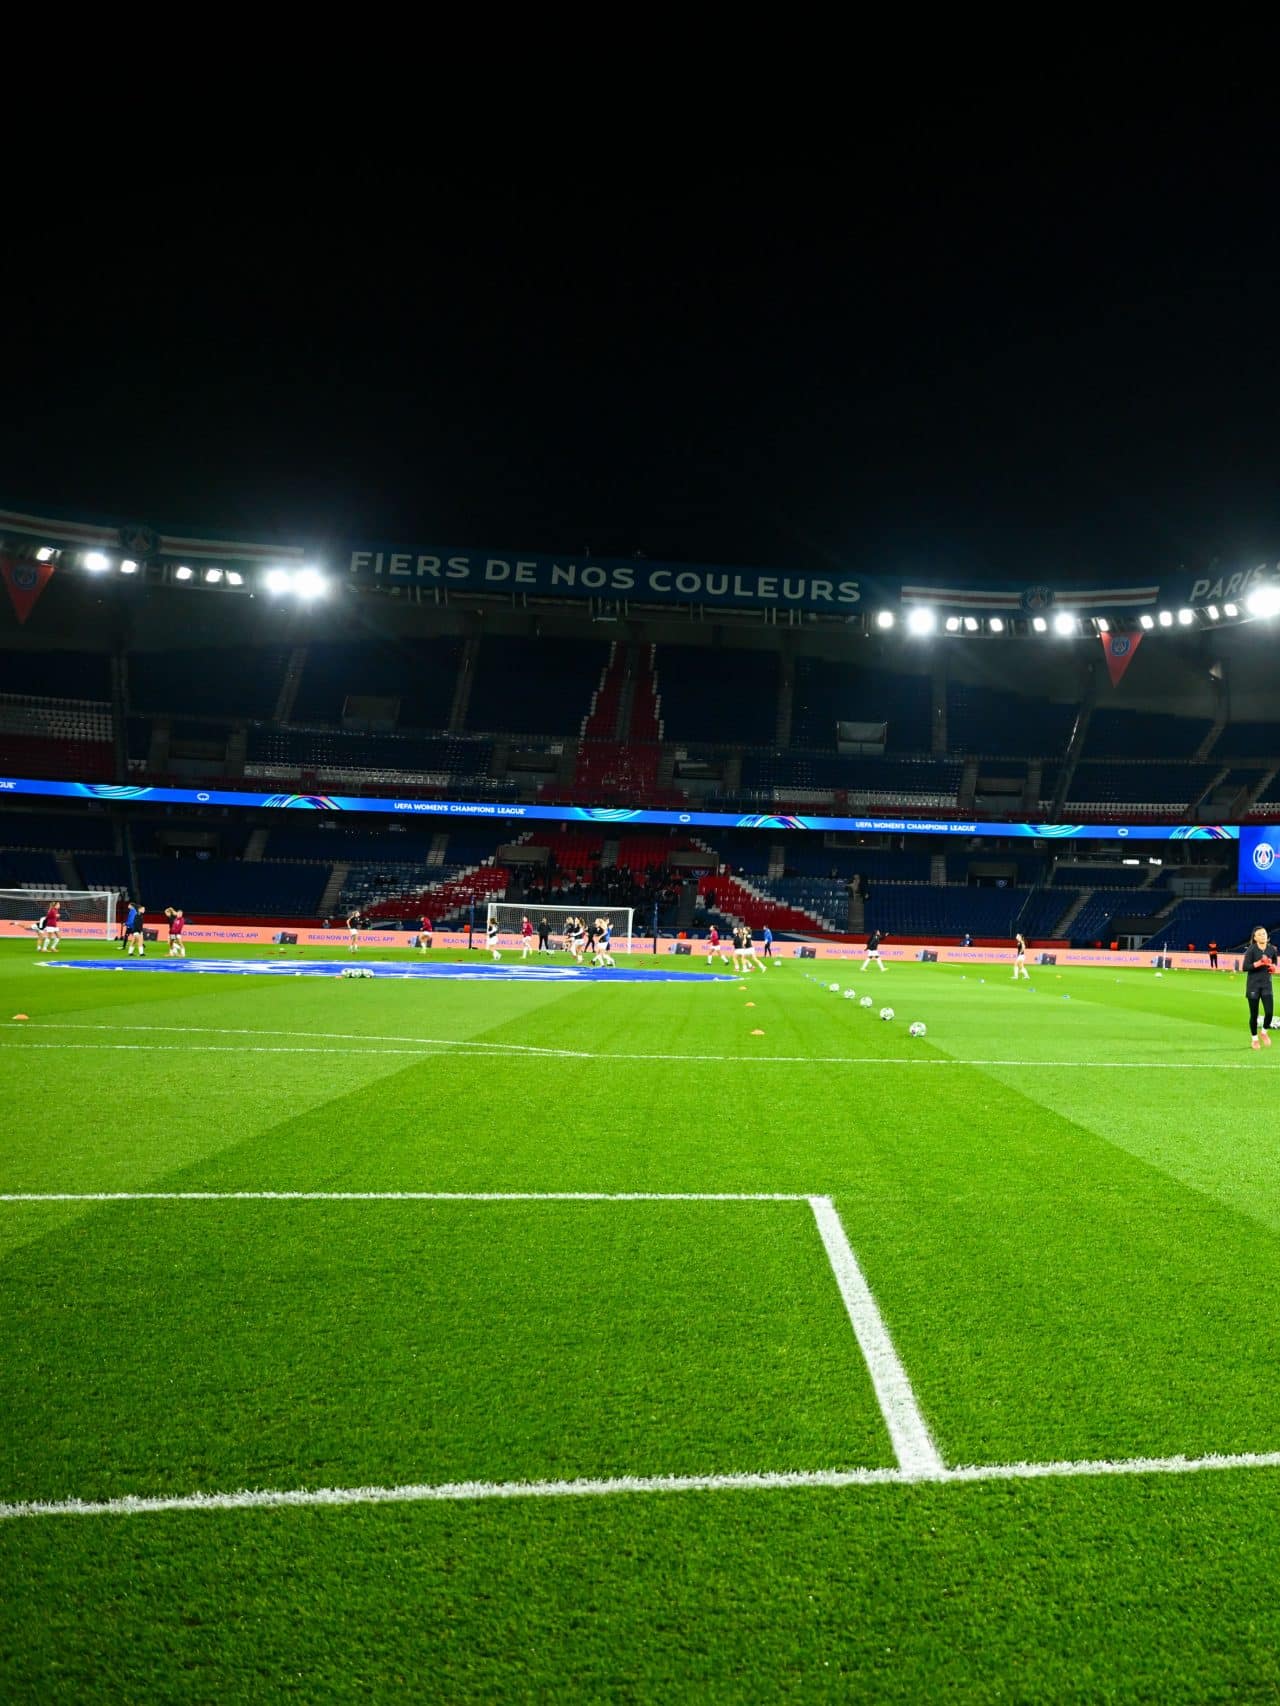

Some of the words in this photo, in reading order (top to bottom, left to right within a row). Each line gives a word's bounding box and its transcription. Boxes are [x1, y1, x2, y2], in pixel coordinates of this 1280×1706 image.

[349, 550, 471, 579] FIERS
[484, 558, 537, 584] DE
[551, 563, 636, 591] NOS
[648, 569, 862, 603] COULEURS
[1188, 562, 1268, 602] PARIS
[394, 802, 413, 810] UEFA
[450, 805, 495, 814] CHAMPIONS
